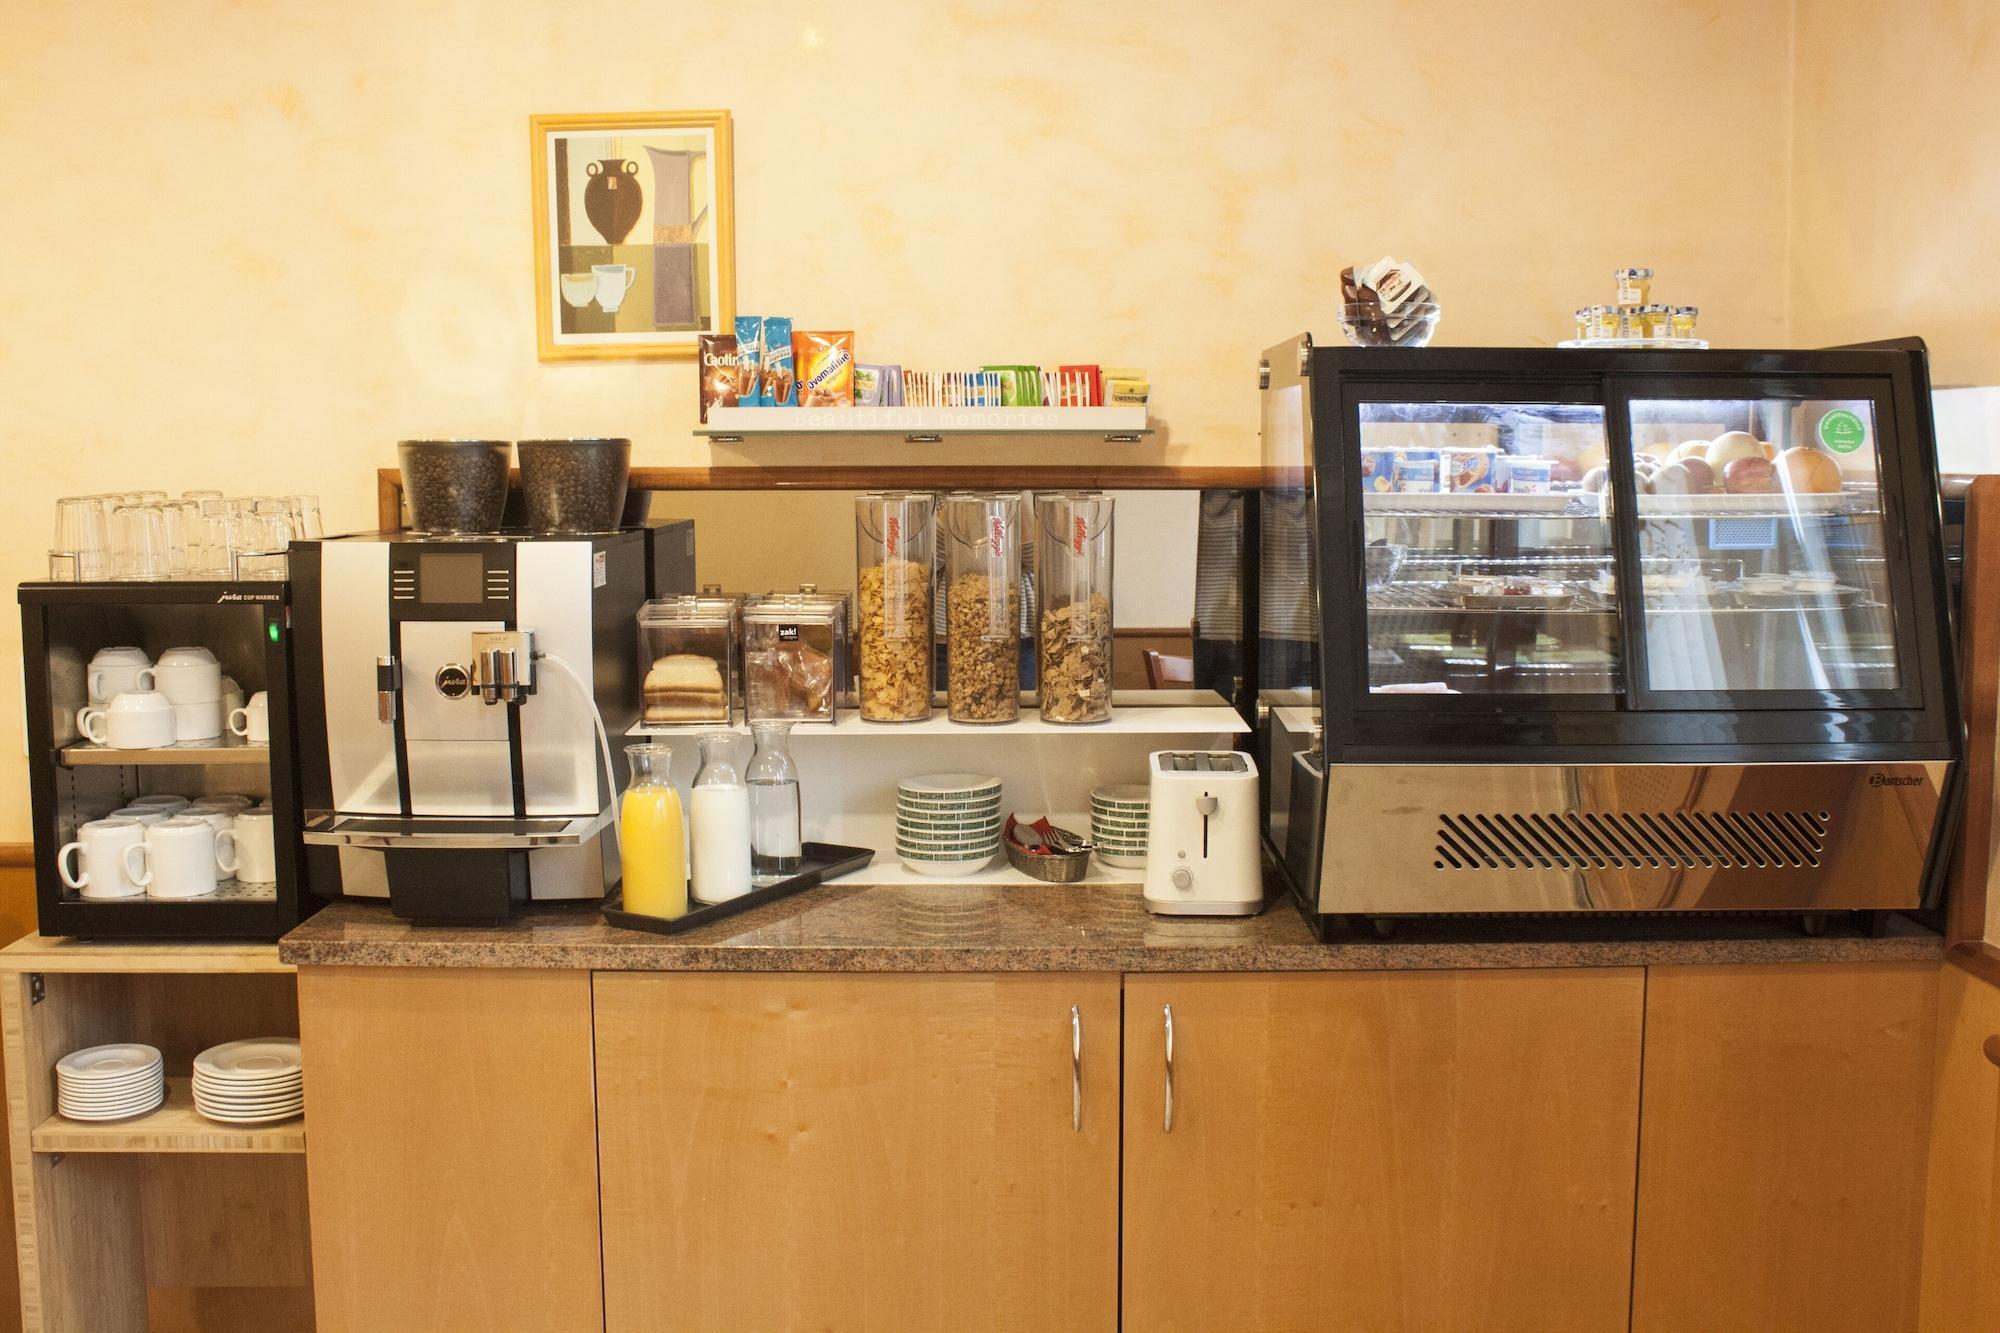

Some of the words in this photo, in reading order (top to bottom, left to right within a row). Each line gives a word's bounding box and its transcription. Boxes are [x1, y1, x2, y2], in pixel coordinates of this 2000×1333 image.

[806, 352, 850, 390] Ovomaltine
[795, 411, 926, 427] Beautiful
[939, 412, 1059, 427] memories
[990, 516, 1006, 557] Kellogg's
[217, 591, 242, 604] jura
[440, 675, 467, 689] jura
[1869, 772, 1923, 788] Bartscher
